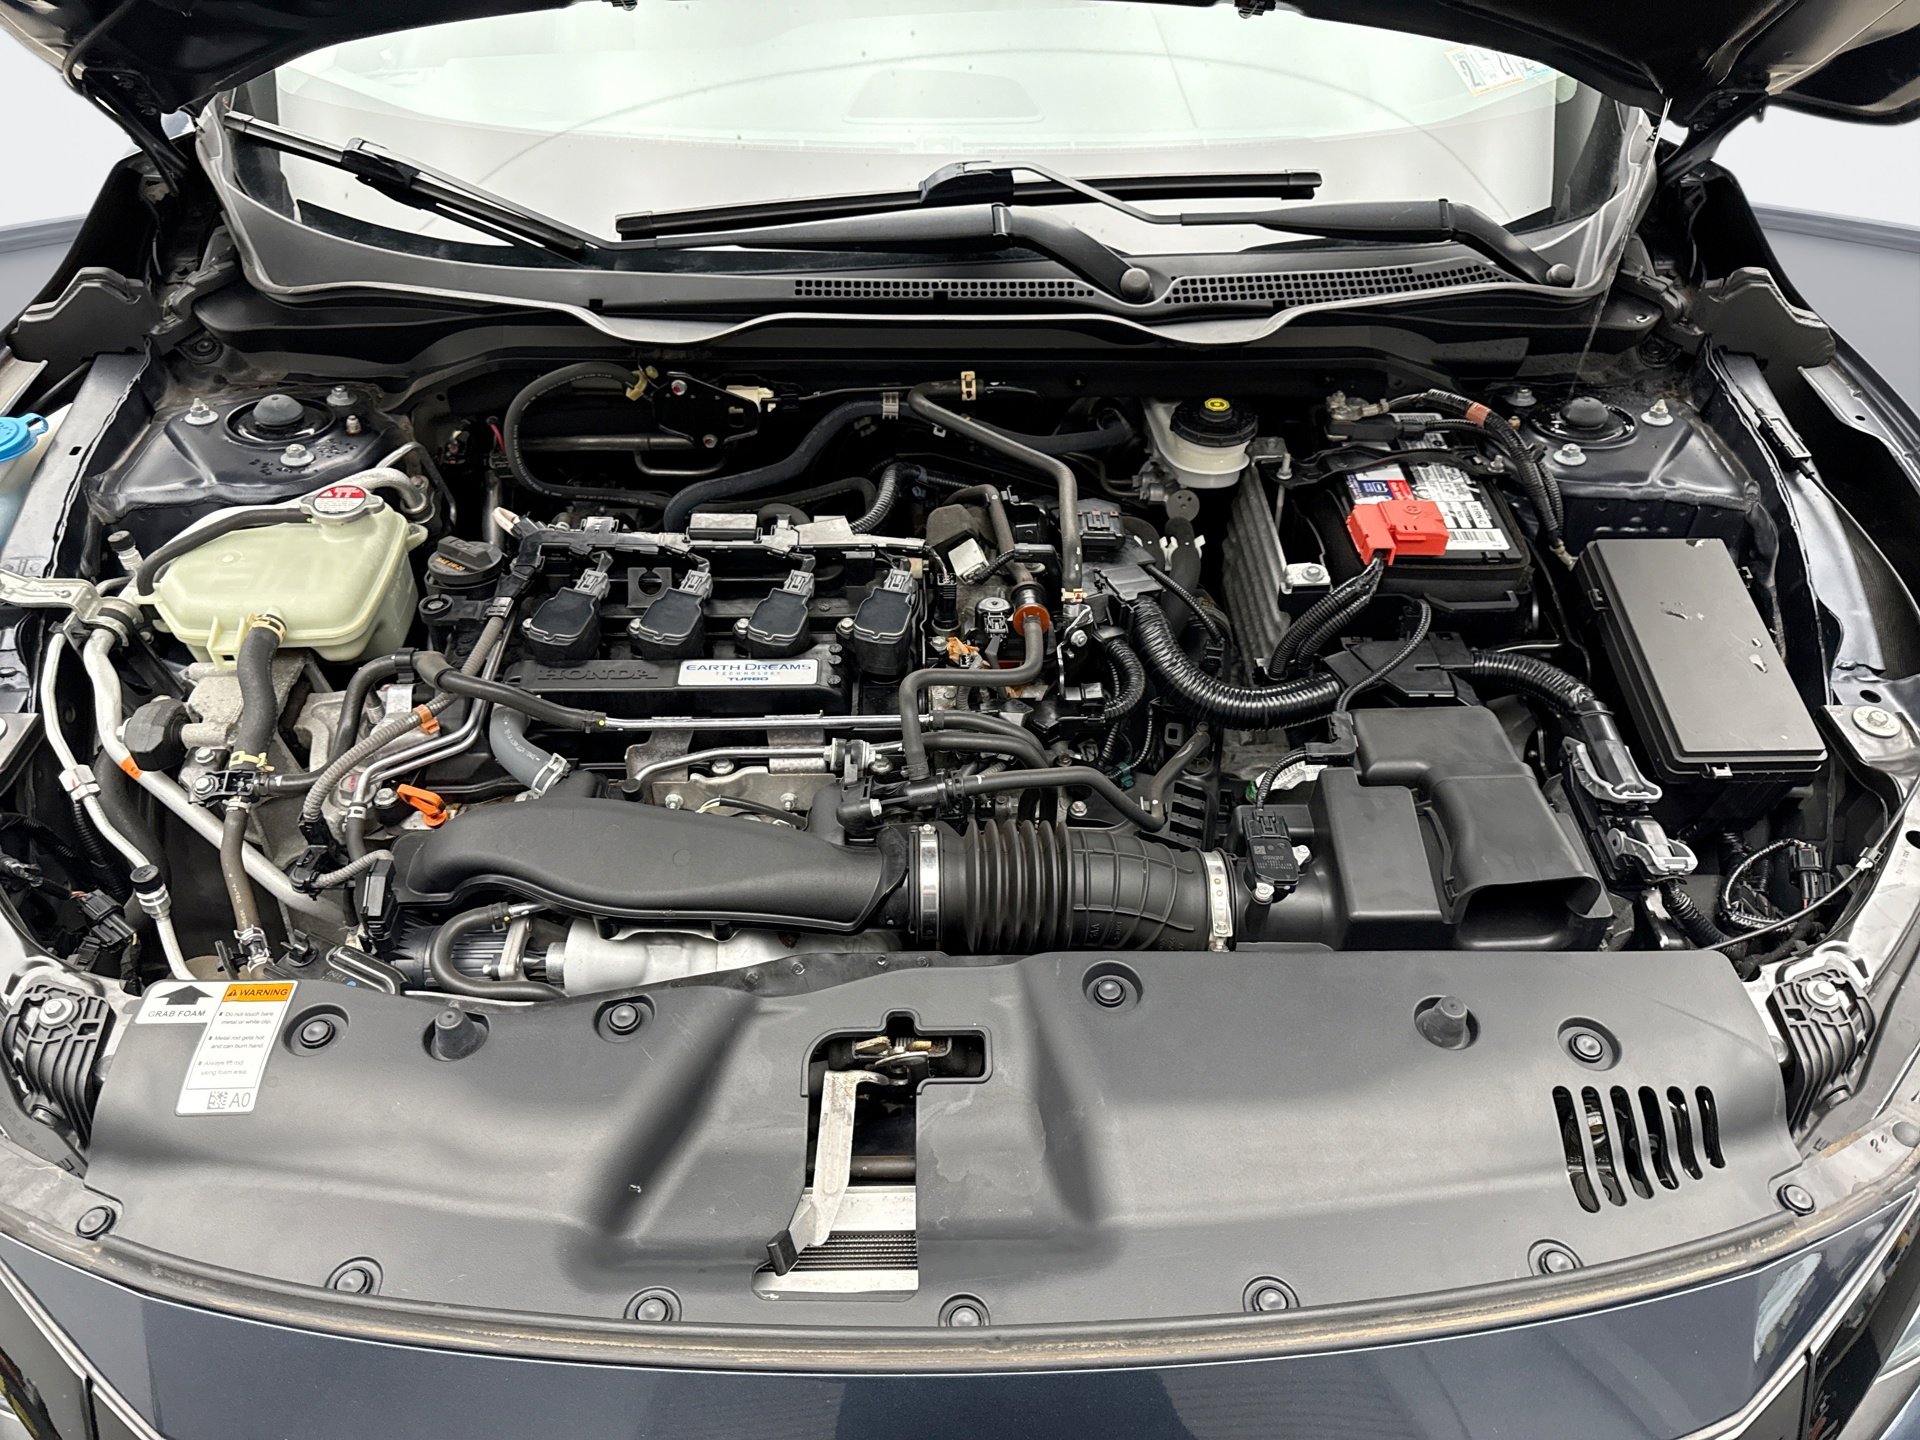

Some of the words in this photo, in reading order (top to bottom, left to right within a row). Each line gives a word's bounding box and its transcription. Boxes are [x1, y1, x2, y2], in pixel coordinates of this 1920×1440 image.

[745, 663, 812, 671] DREAMS
[537, 669, 658, 681] HONDA
[240, 988, 289, 996] WARNING
[148, 1010, 175, 1018] GRAB
[228, 1092, 251, 1108] A0
